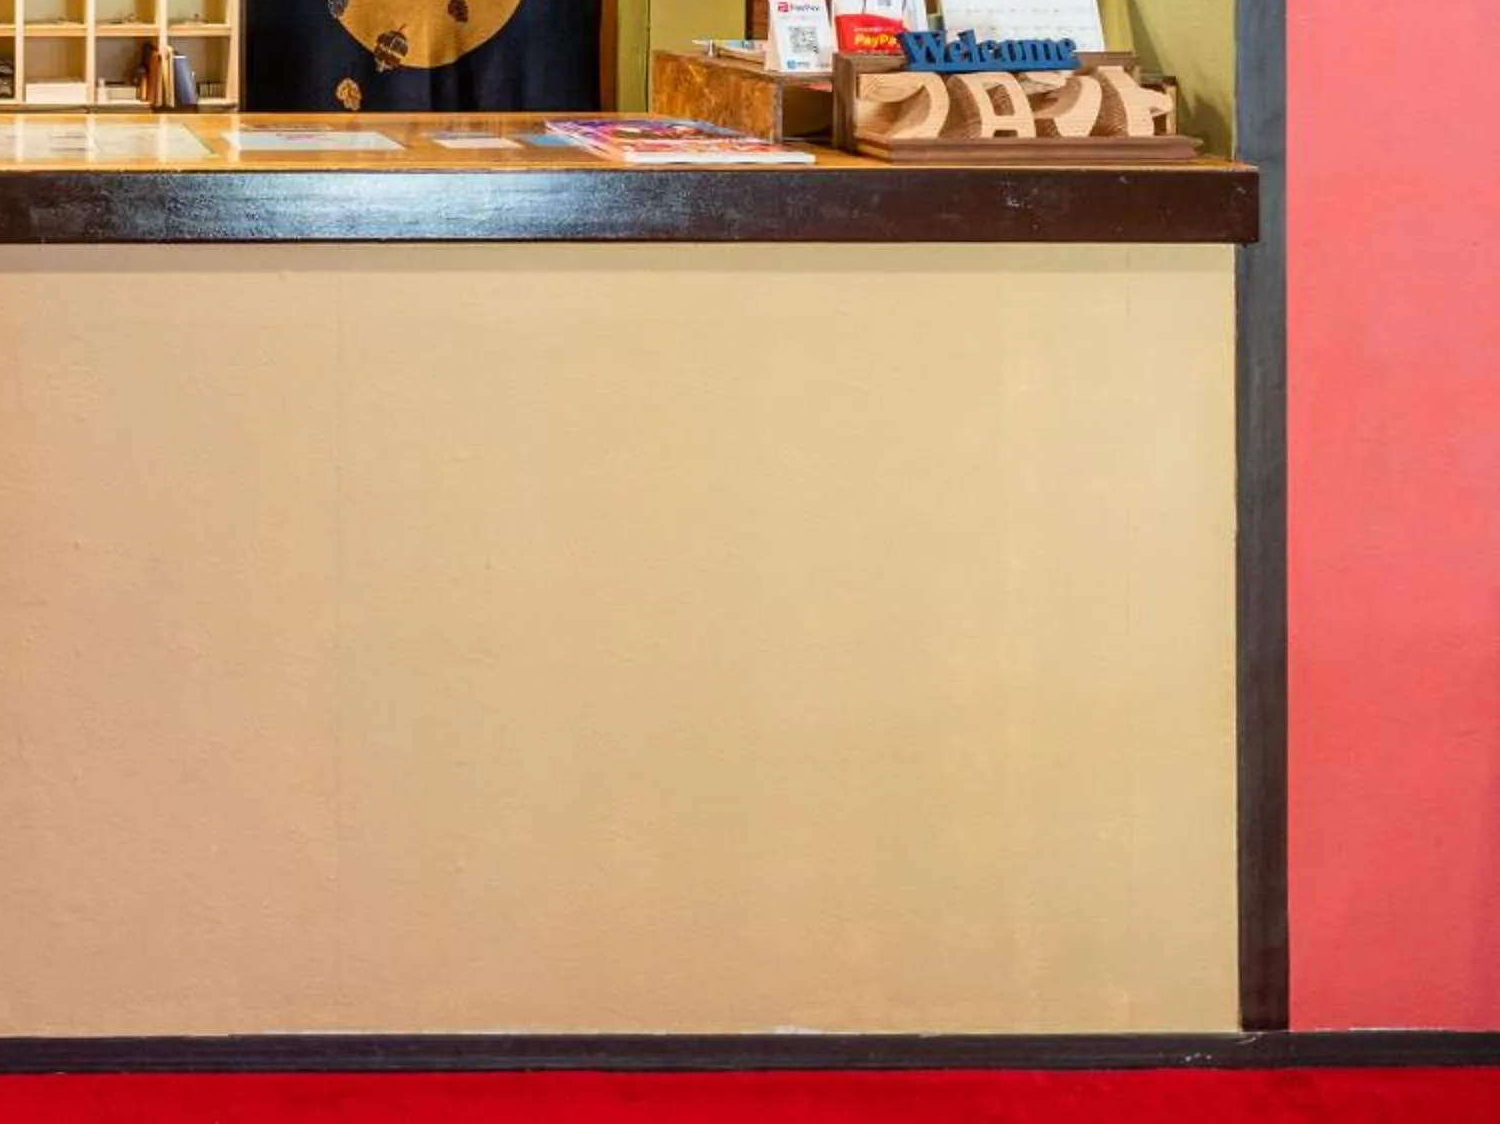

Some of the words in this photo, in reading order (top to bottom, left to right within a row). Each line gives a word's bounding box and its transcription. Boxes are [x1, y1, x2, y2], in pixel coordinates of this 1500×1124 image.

[899, 29, 1078, 66] Welcome
[857, 66, 1174, 139] フロント
